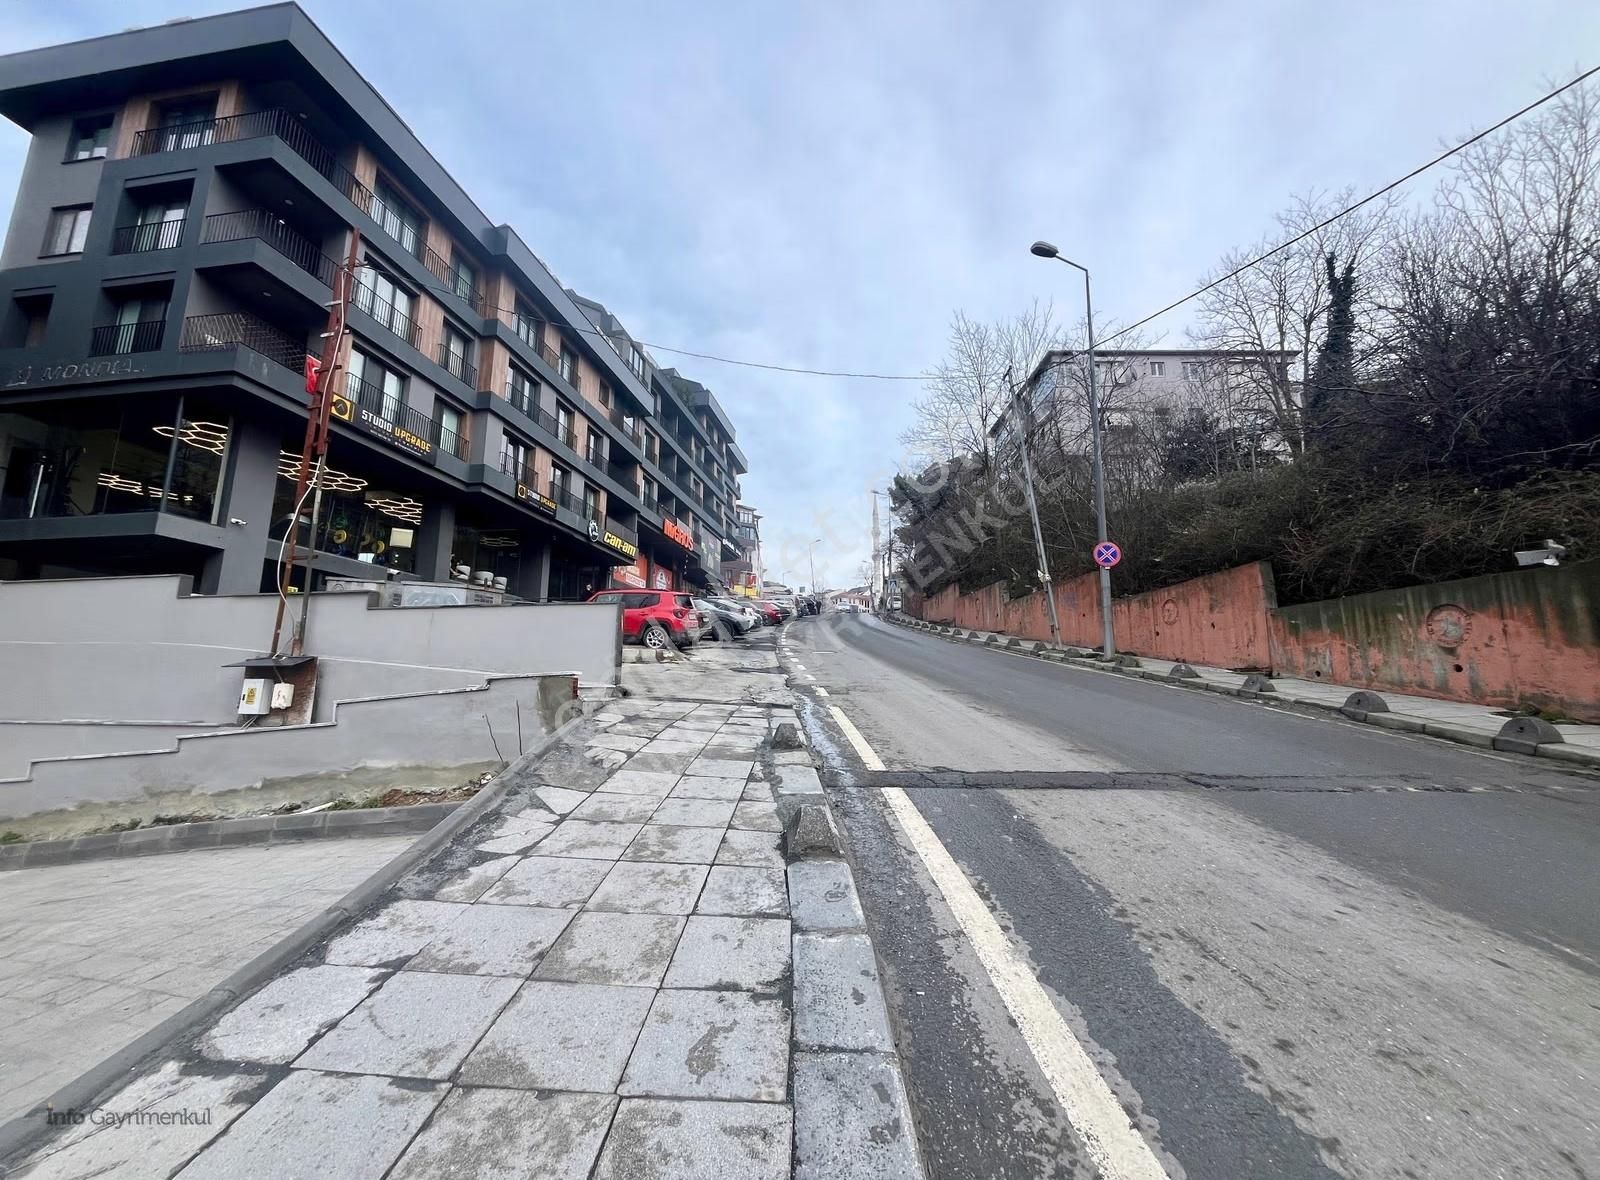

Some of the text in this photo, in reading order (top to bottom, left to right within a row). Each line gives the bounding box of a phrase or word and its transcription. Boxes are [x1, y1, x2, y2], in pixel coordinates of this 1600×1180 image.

[361, 409, 393, 433] STUDIO
[394, 426, 432, 454] UPGRADE
[603, 531, 636, 557] can-am
